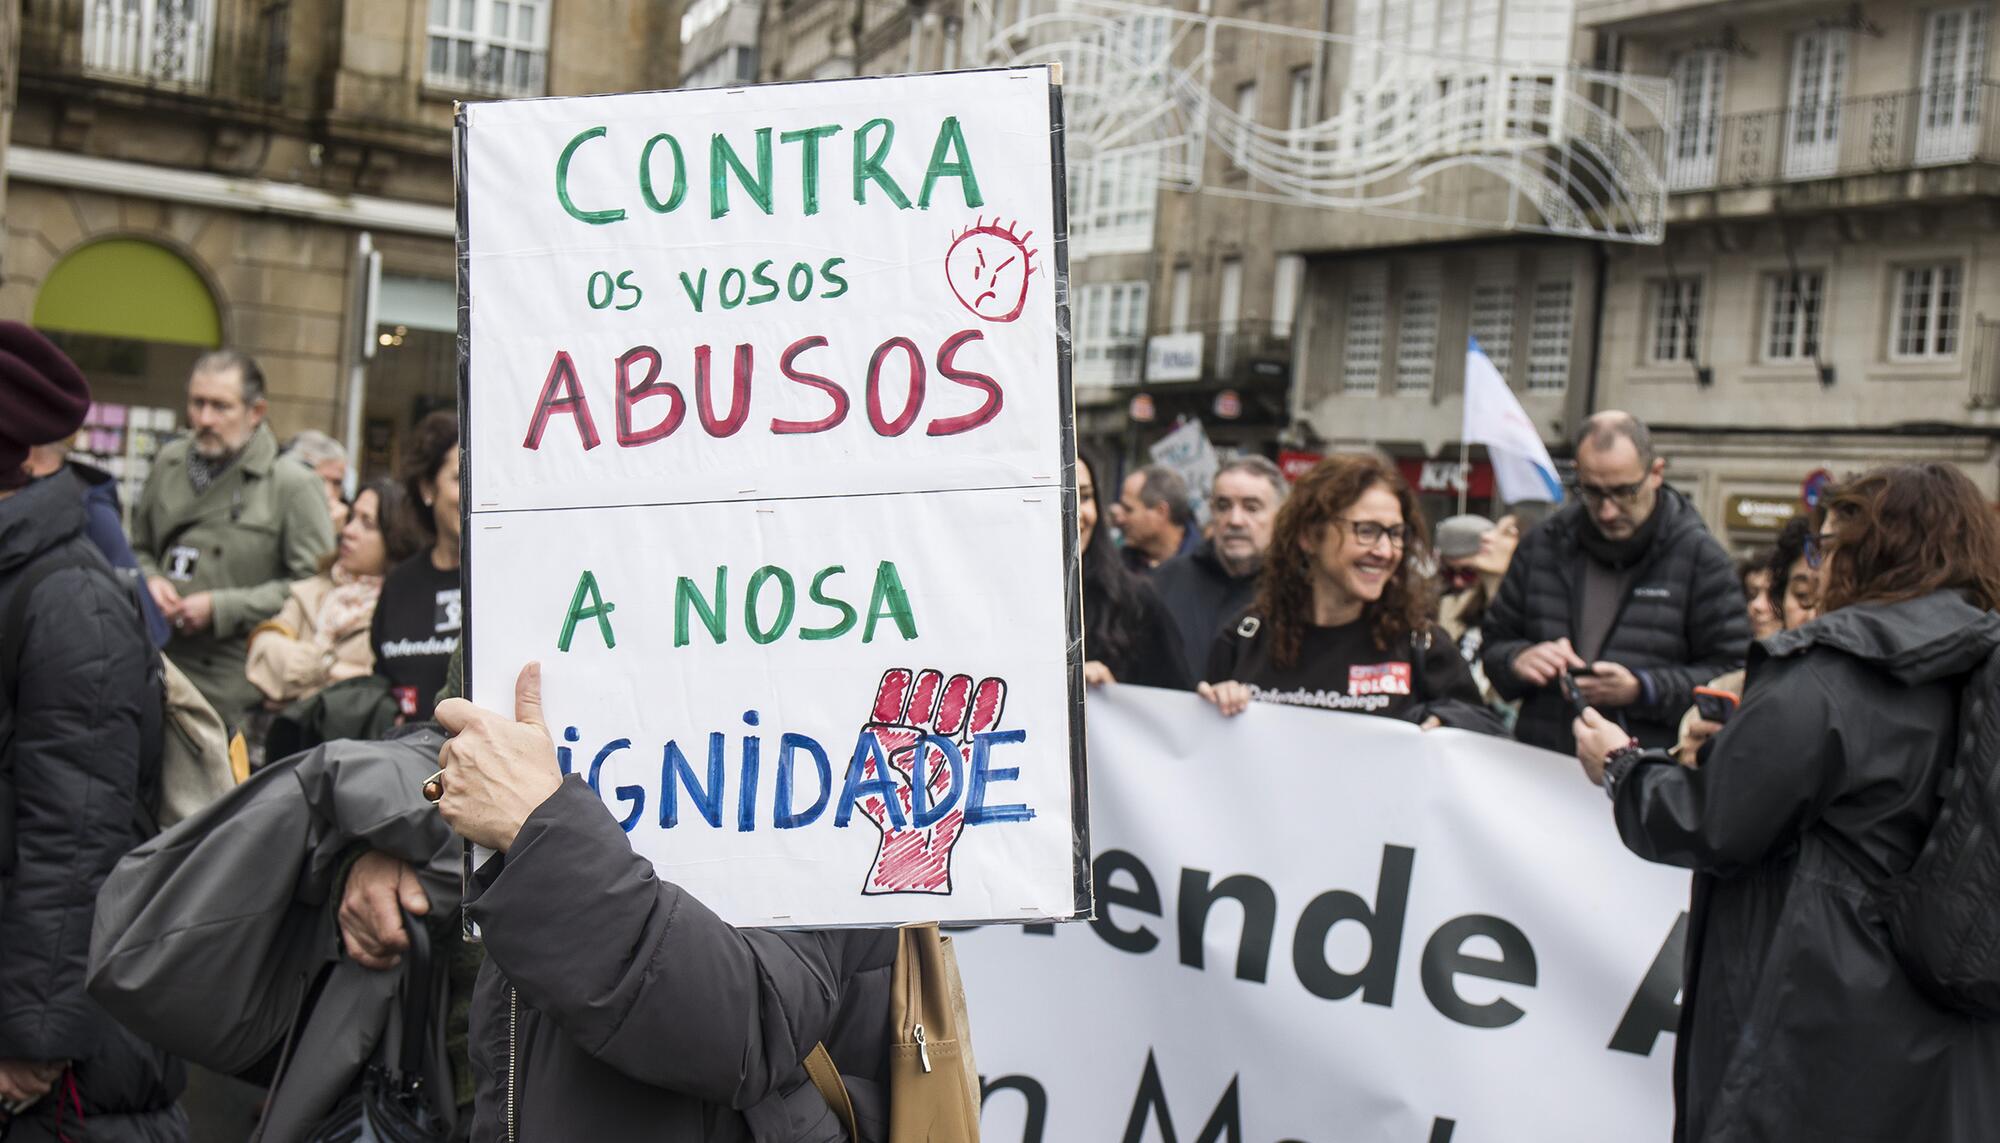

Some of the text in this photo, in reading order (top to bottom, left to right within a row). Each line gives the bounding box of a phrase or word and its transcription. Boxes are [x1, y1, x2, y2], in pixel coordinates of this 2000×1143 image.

[556, 116, 985, 225] CONTRA
[587, 257, 849, 312] OS VOSOS
[523, 330, 1004, 451] ABUSOS
[1419, 461, 1471, 491] KFC
[558, 561, 919, 652] A NOSA
